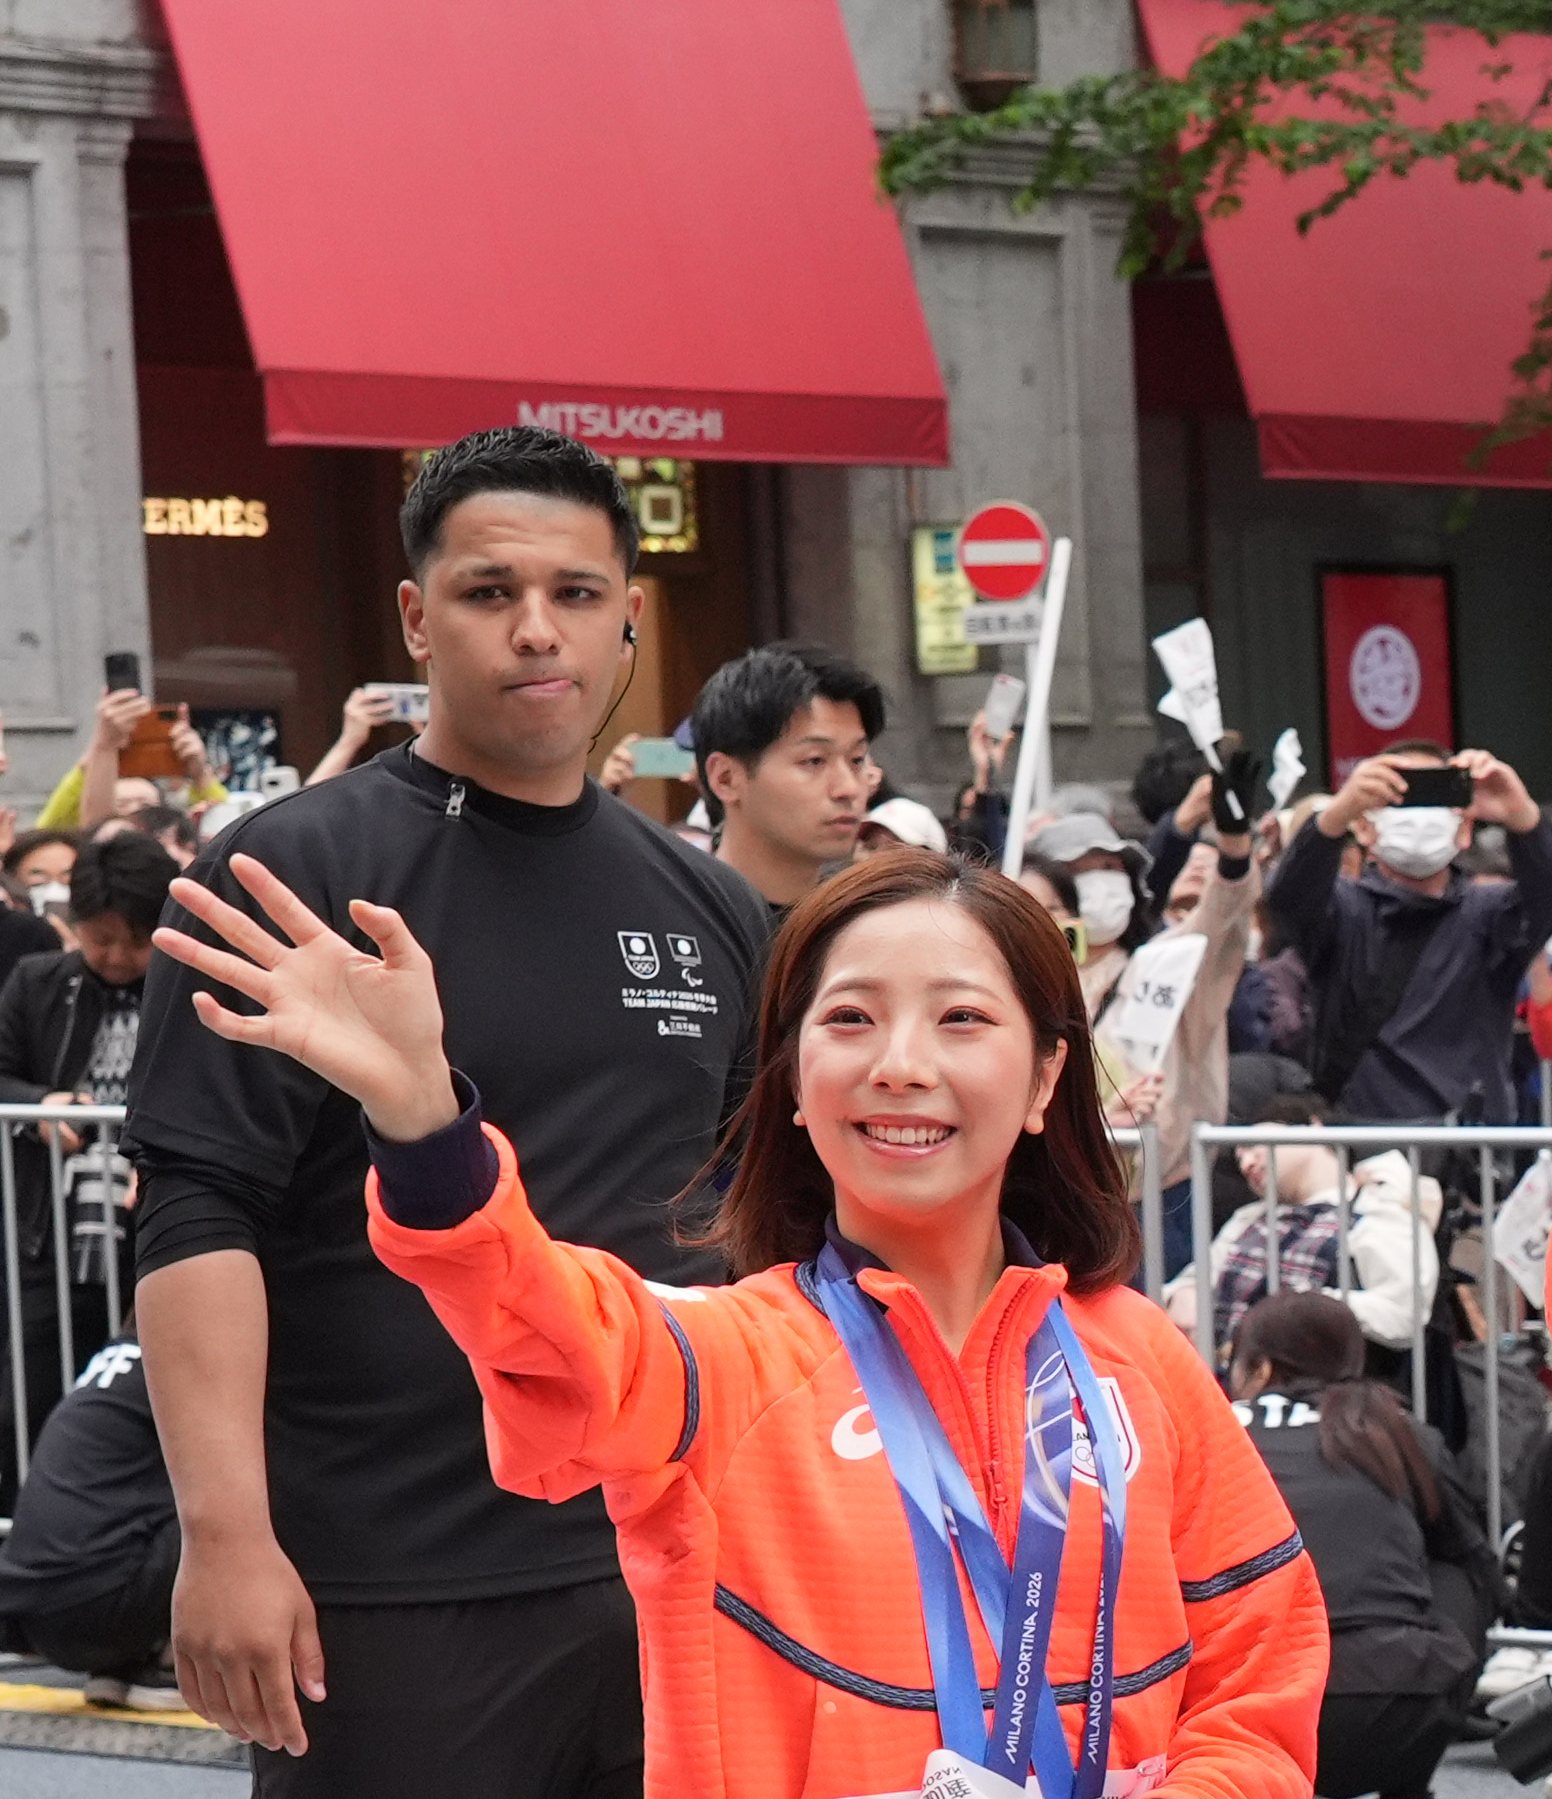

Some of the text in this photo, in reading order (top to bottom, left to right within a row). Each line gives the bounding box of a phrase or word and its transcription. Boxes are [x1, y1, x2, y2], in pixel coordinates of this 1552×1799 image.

[517, 401, 724, 441] MITSUKOSHI
[142, 495, 269, 538] ERMÈS
[1231, 1393, 1322, 1429] STA
[1004, 1571, 1043, 1765] MILANO CORTINA 2026
[1089, 1611, 1105, 1688] CORTINA
[1087, 1691, 1103, 1765] MILANO
